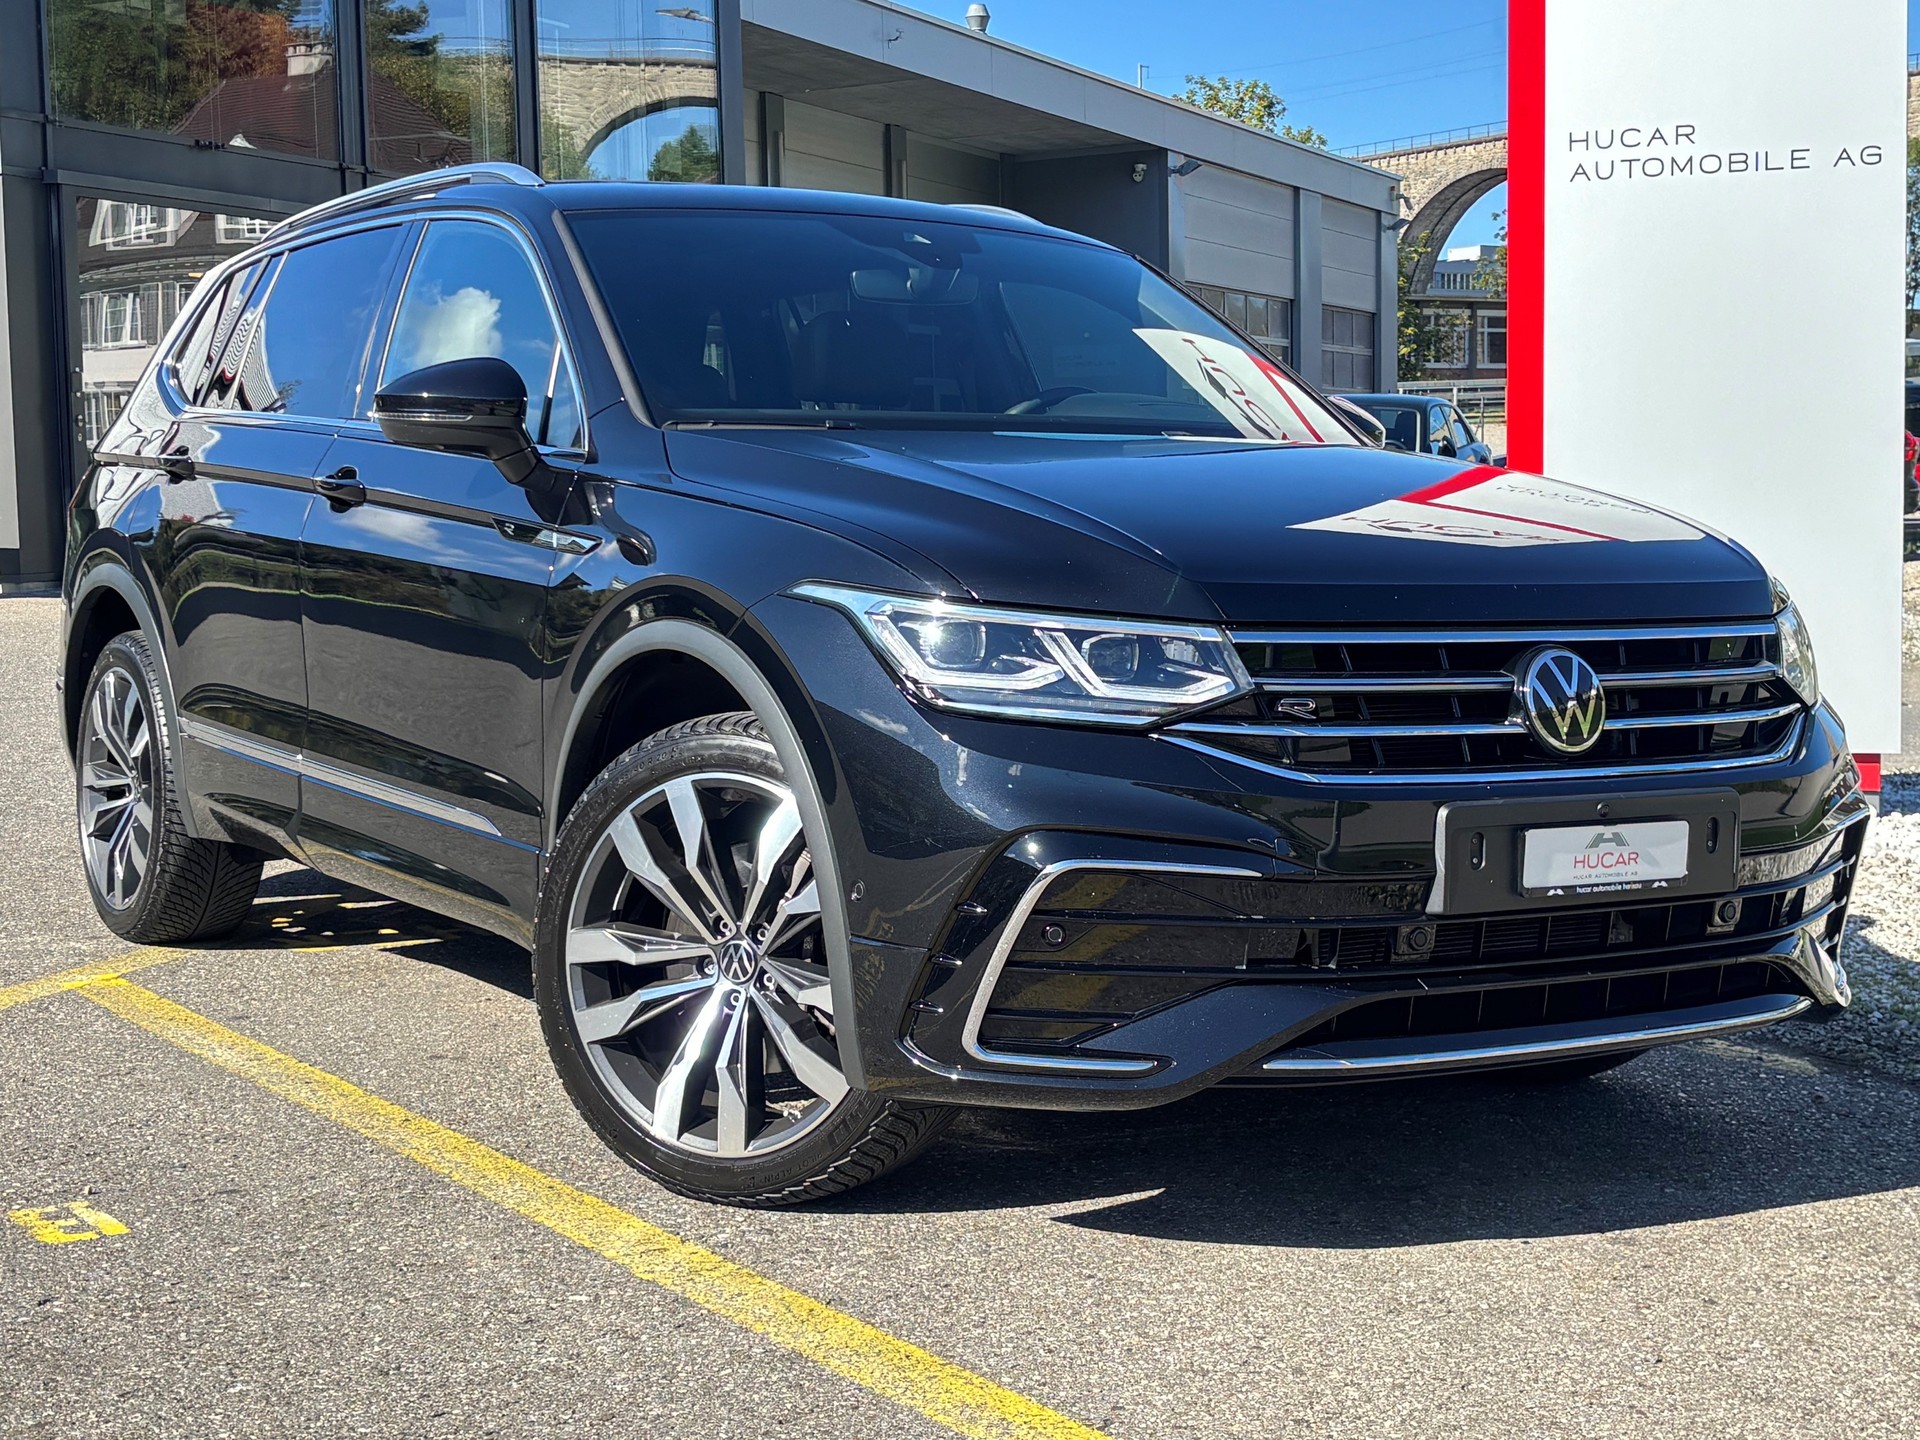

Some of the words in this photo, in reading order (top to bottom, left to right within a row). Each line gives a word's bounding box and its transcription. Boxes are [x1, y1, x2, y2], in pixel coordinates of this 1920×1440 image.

[1568, 124, 1697, 152] HUCAR
[1569, 148, 1811, 183] AUTOMOBILE
[1833, 145, 1882, 168] AG
[1526, 648, 1606, 753] VW
[1573, 851, 1640, 869] HUCAR
